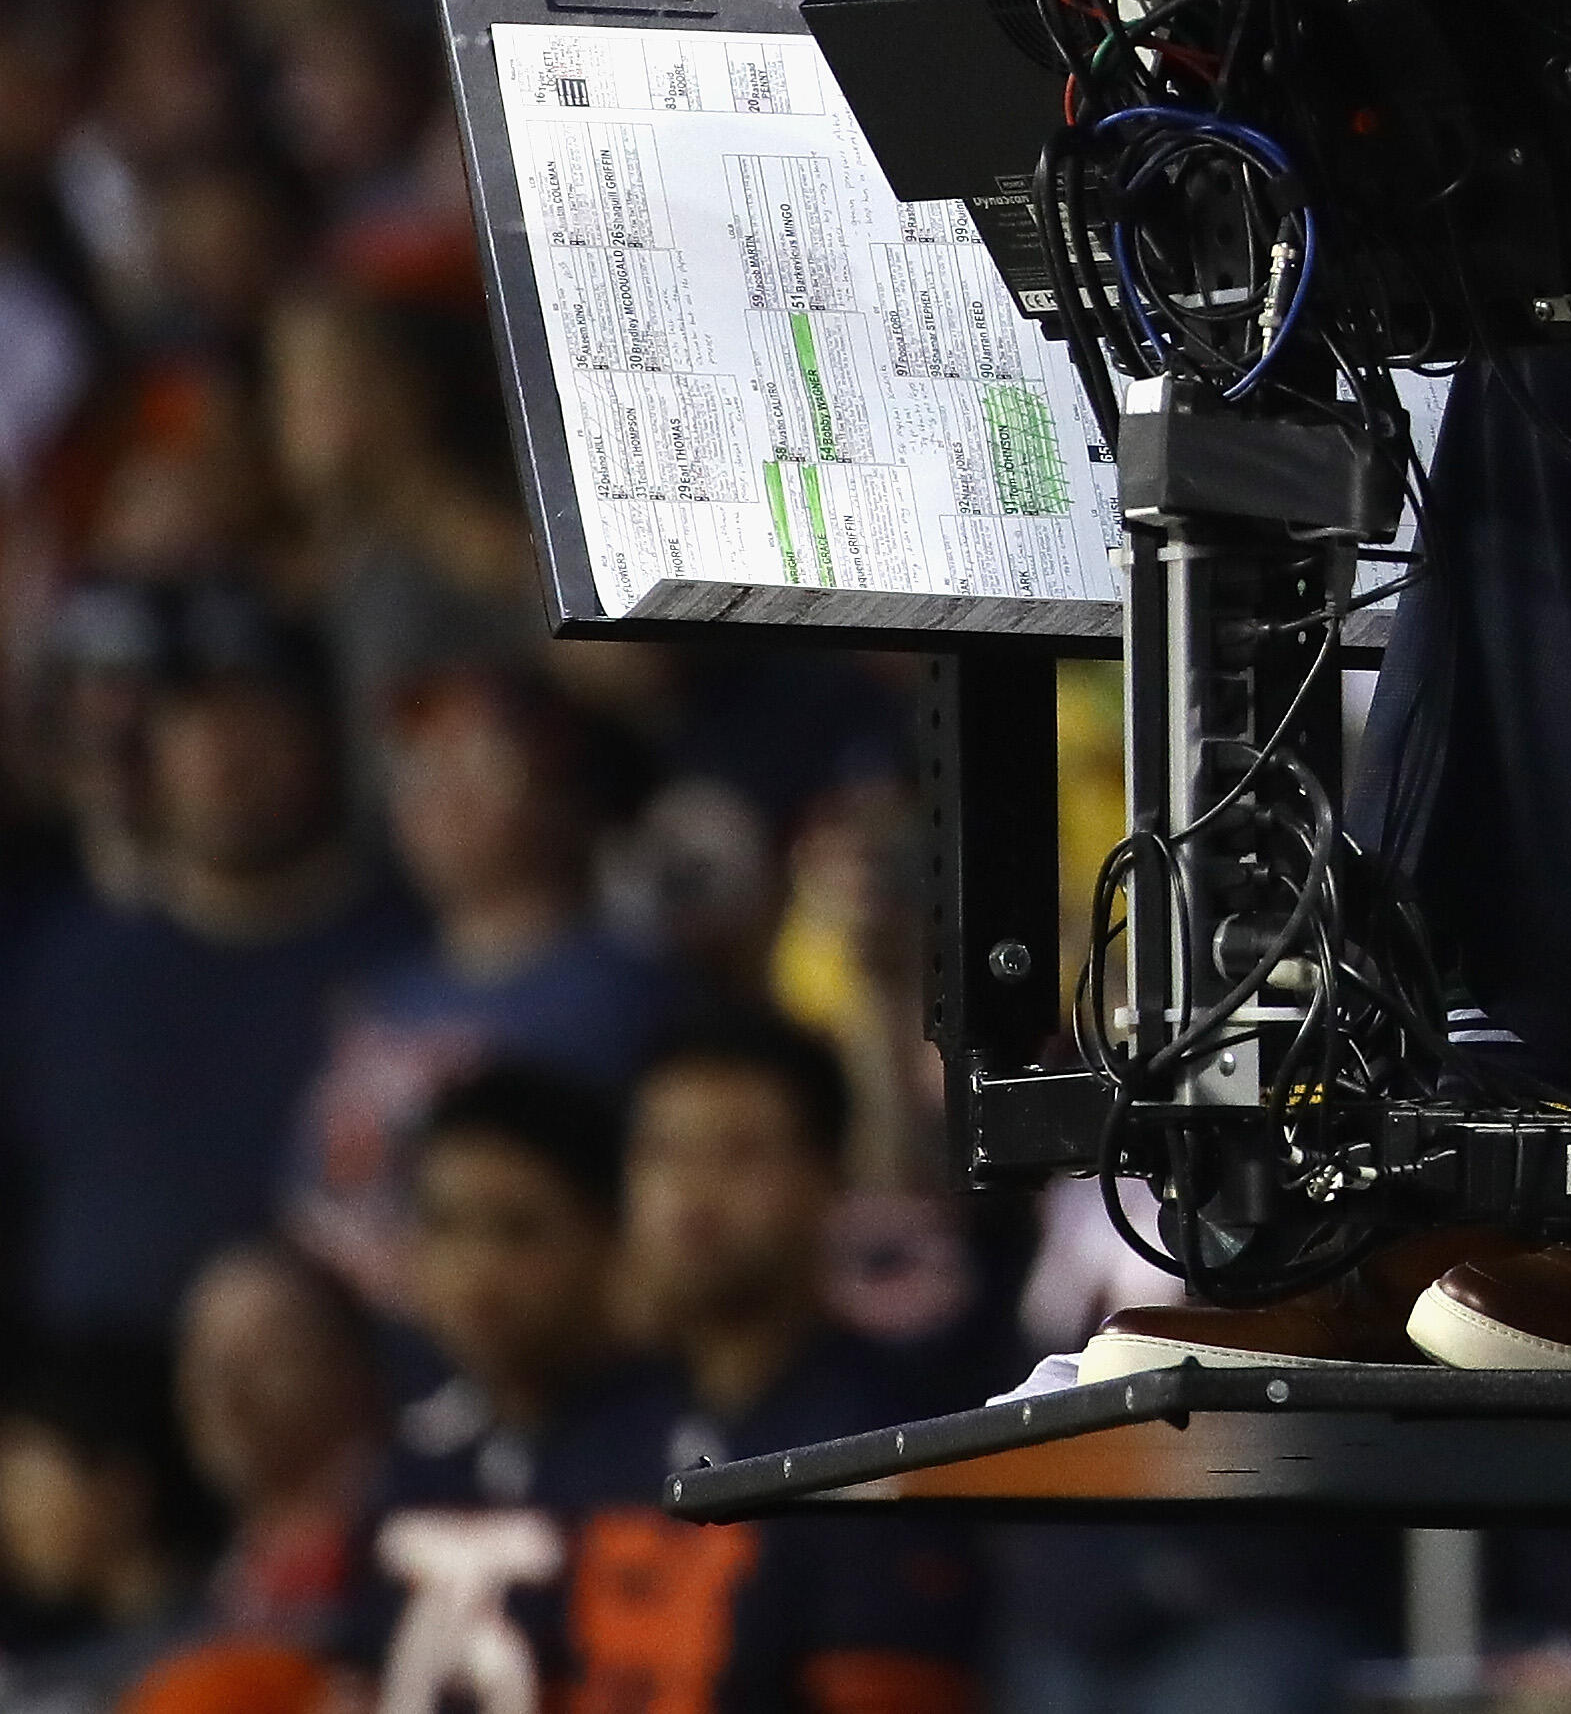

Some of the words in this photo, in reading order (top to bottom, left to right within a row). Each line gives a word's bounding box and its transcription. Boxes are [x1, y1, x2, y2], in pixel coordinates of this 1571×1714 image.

[666, 71, 678, 96] David
[674, 63, 687, 96] MOORE
[759, 69, 771, 99] PENNY
[535, 91, 547, 104] 16
[664, 96, 677, 110] 83
[748, 99, 761, 113] 20
[600, 148, 617, 189] GRIFFIN
[547, 160, 563, 204] COLEMAN
[780, 203, 796, 237] MINGO
[552, 231, 565, 245] 28
[611, 231, 626, 246] 26
[904, 229, 917, 242] 94
[954, 228, 969, 243] 99
[744, 235, 759, 268] MARTIN
[613, 249, 635, 315] MCDOUGALD
[751, 295, 765, 308] 59
[789, 295, 805, 310] 51
[919, 289, 936, 331] STEPHEN
[573, 303, 586, 325] KING
[888, 310, 902, 334] FORD
[971, 300, 988, 329] REED
[626, 316, 641, 354] Bradley
[576, 355, 589, 368] 36
[629, 355, 644, 370] 30
[894, 364, 908, 376] 97
[929, 364, 942, 377] 98
[979, 363, 995, 379] 90
[807, 368, 828, 411] WAGNER
[626, 407, 643, 457] THOMPSON
[670, 417, 688, 461] THOMAS
[819, 412, 834, 446] Bobby
[593, 435, 605, 454] HILL
[774, 446, 788, 461] 58
[820, 447, 835, 461] 54
[998, 425, 1015, 475] JOHNSON
[952, 441, 967, 472] JONES
[678, 464, 692, 484] Earl
[598, 485, 611, 498] 42
[635, 485, 648, 499] 33
[678, 485, 692, 500] 29
[958, 501, 971, 514] 92
[1003, 500, 1019, 514] 91
[843, 515, 860, 554] GRIFFIN
[667, 537, 686, 578] THORPE
[1018, 570, 1034, 597] LARK
